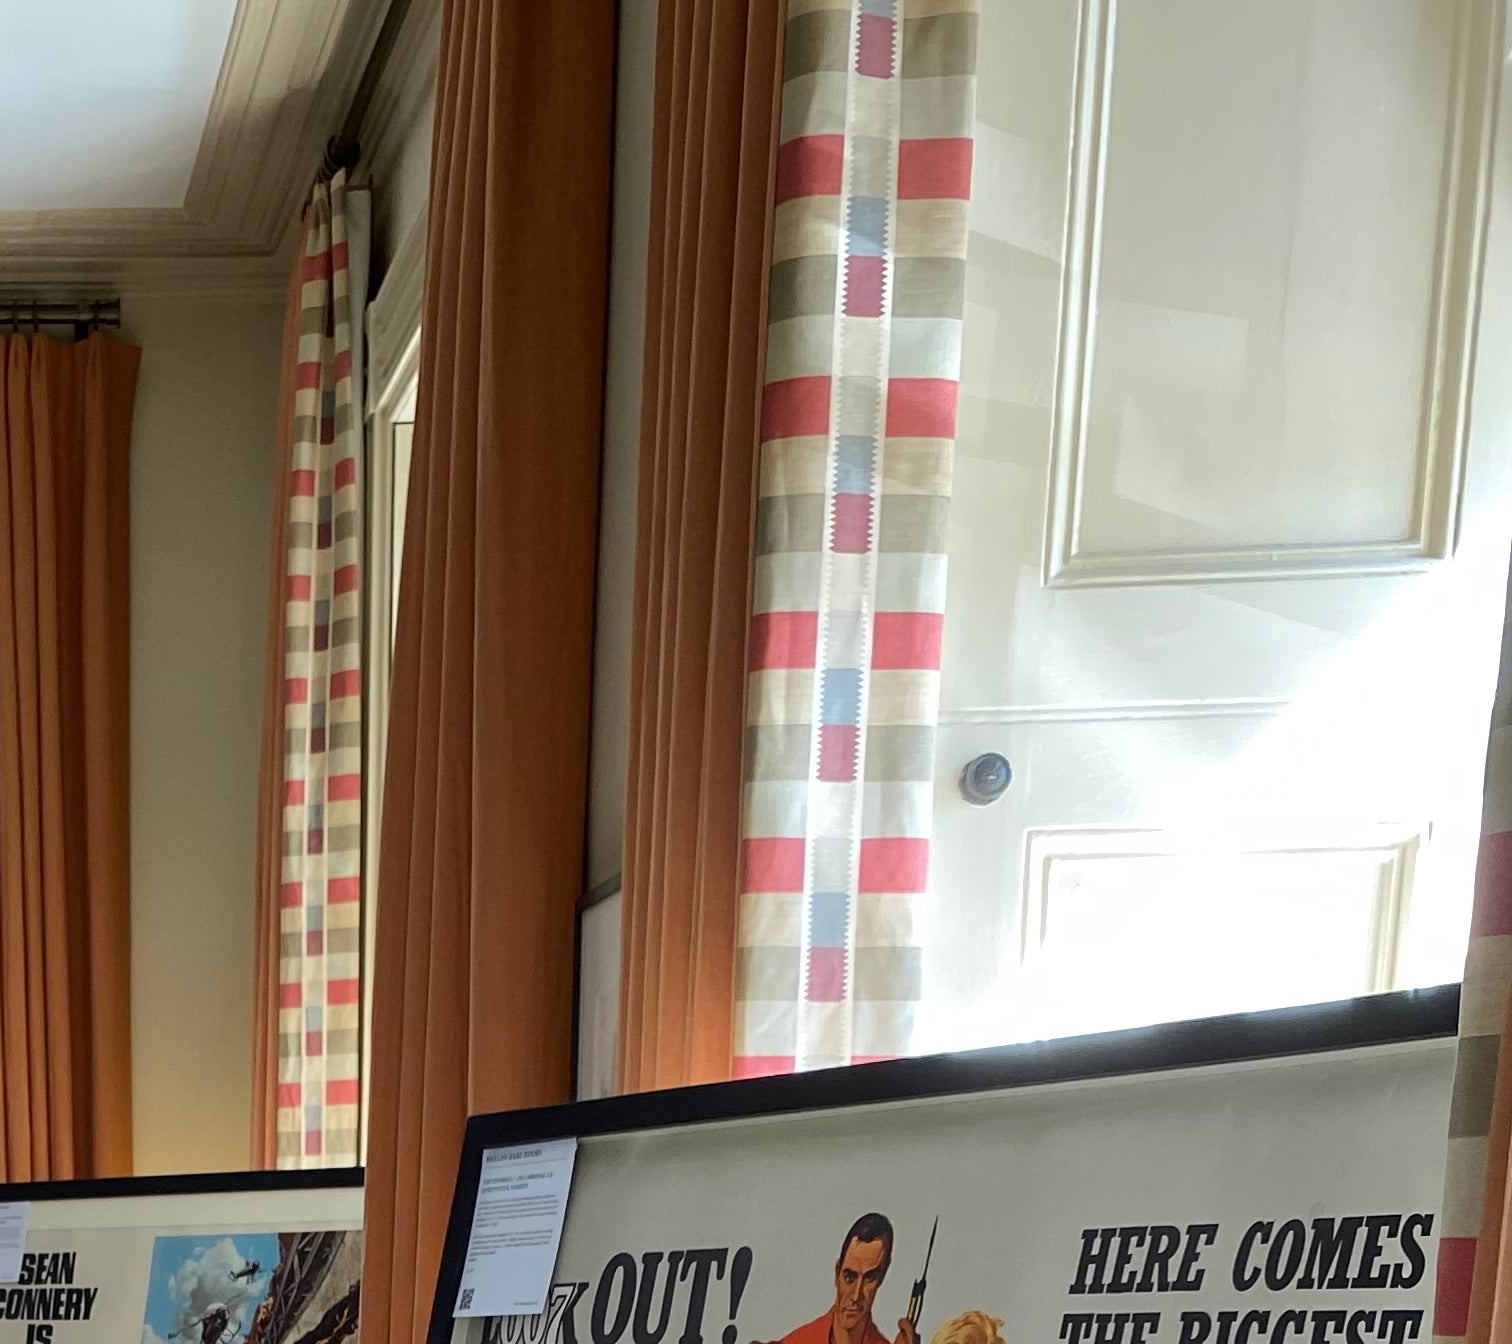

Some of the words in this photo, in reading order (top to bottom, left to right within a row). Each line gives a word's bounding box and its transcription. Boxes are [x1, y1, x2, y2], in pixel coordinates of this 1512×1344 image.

[18, 1252, 76, 1285] SEAN
[1069, 1224, 1219, 1294] HERE
[1232, 1214, 1435, 1292] COMES
